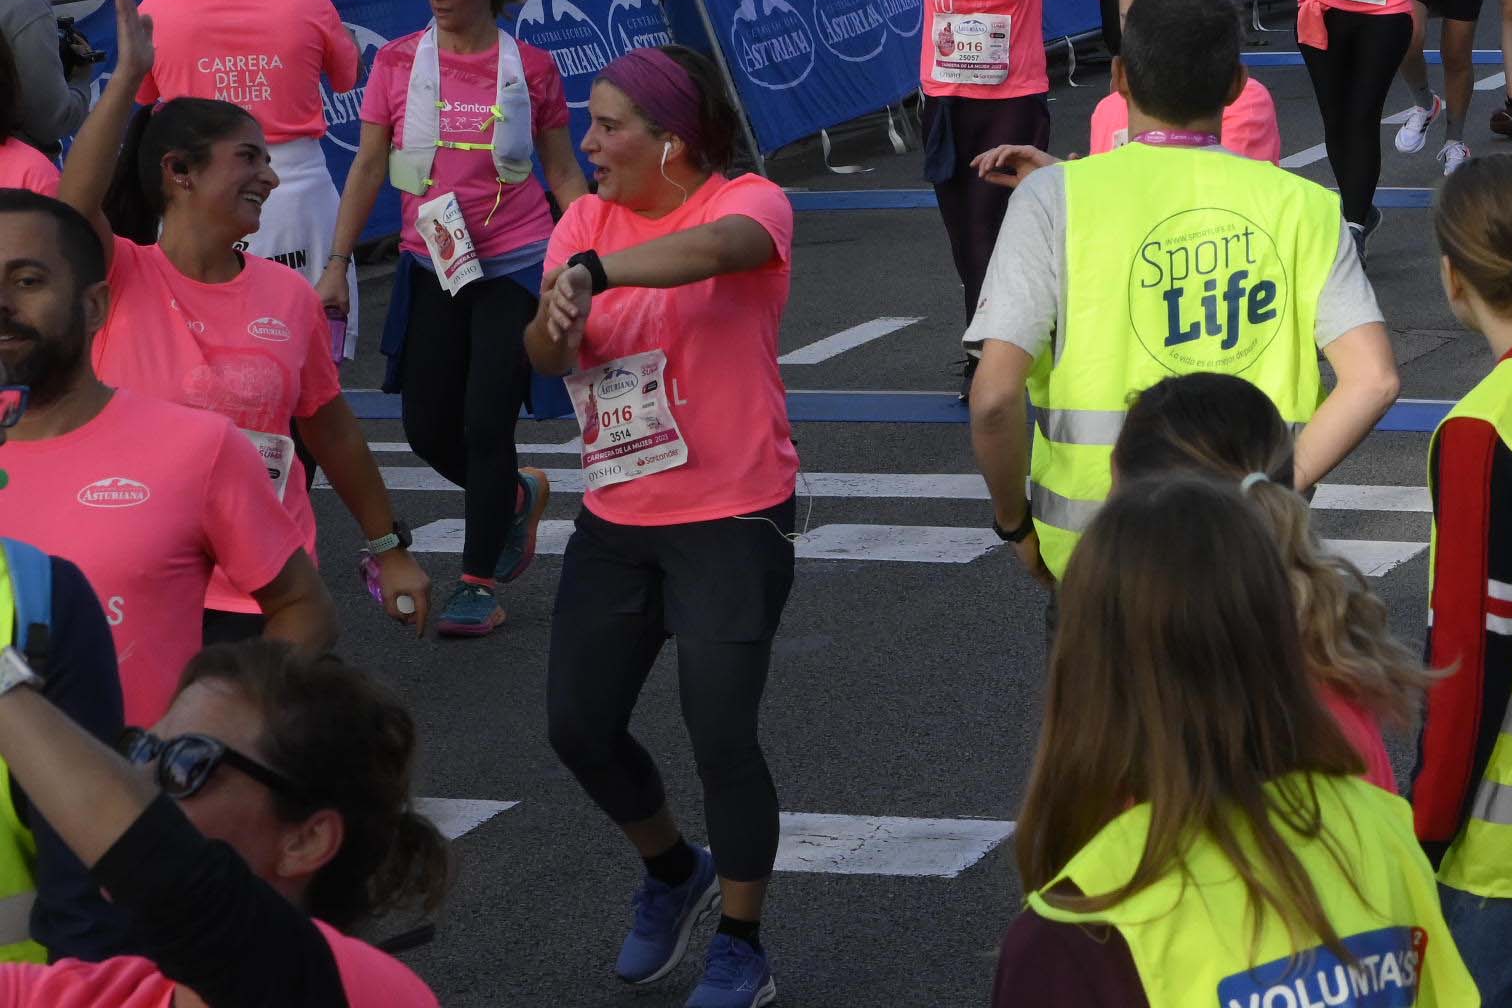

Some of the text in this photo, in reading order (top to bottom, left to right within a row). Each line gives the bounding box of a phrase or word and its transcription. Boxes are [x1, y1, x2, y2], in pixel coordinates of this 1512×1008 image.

[957, 41, 983, 52] 016
[197, 55, 284, 73] CARRERA
[216, 71, 269, 88] DE LA
[214, 86, 272, 103] MUJER
[1141, 226, 1257, 290] Sport
[1163, 270, 1278, 350] Life
[1179, 354, 1196, 366] vida
[601, 405, 633, 429] 016
[609, 429, 632, 443] 3514
[587, 450, 615, 463] CARRERA
[645, 449, 679, 465] Santander
[588, 465, 622, 482] OYSHO
[83, 487, 145, 503] ASTURIANA
